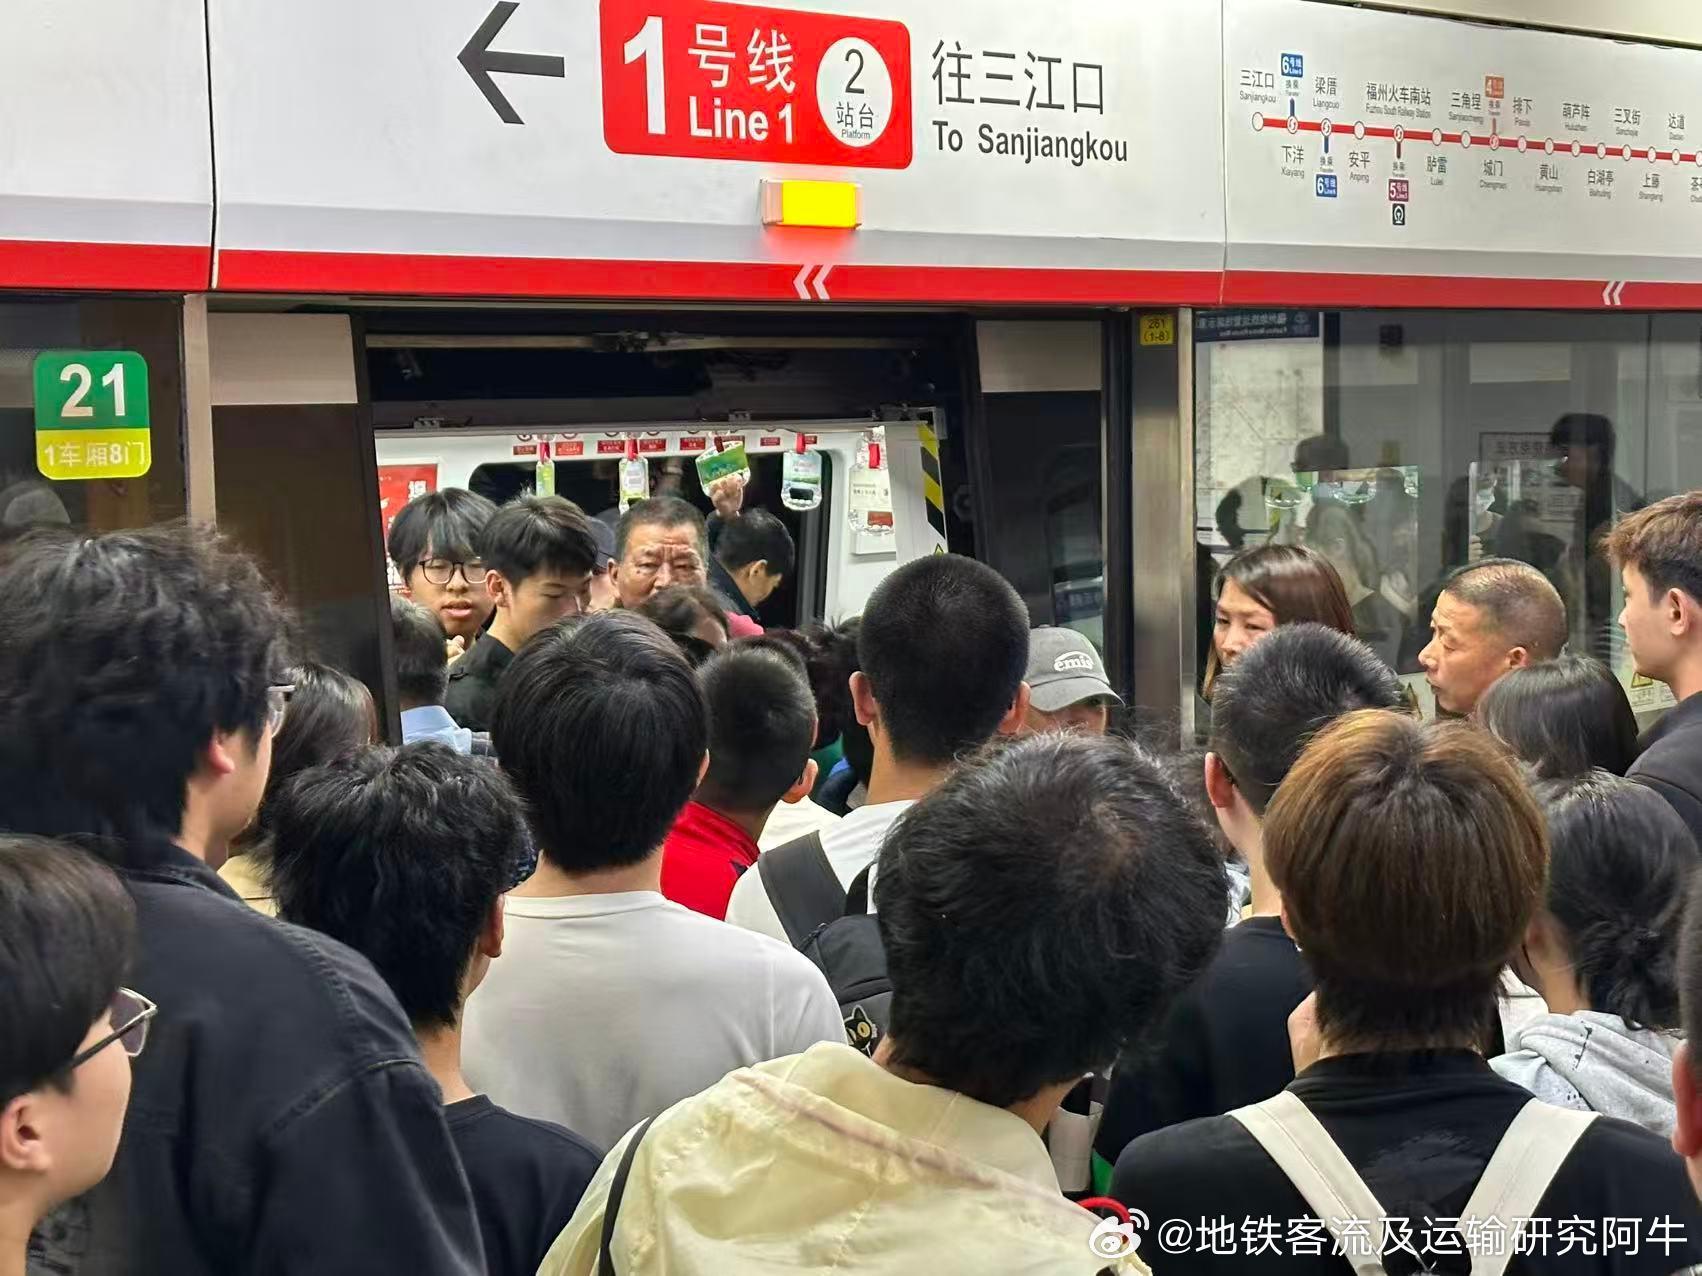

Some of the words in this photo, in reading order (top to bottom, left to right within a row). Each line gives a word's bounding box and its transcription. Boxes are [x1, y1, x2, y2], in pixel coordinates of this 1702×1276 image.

[624, 16, 666, 135] 1
[688, 23, 796, 94] 号线
[845, 48, 865, 94] 2
[932, 39, 1103, 115] 往三江口
[1240, 69, 1274, 88] 三江口
[1239, 90, 1277, 104] Sanjiangkou
[1366, 82, 1431, 106] 福州火车南站
[689, 96, 768, 141] Line
[778, 103, 793, 144] 1
[836, 101, 874, 129] 站台
[1614, 107, 1641, 126] 三叉街
[1667, 112, 1685, 130] 达道
[841, 128, 871, 140] Platform
[932, 120, 963, 152] To
[978, 123, 1127, 167] Sanjiangkou
[1281, 145, 1305, 165] 下洋
[1348, 151, 1371, 169] 安平
[1539, 162, 1559, 180] 黄山
[60, 363, 126, 417] 21
[44, 441, 146, 468] 1车厢8门
